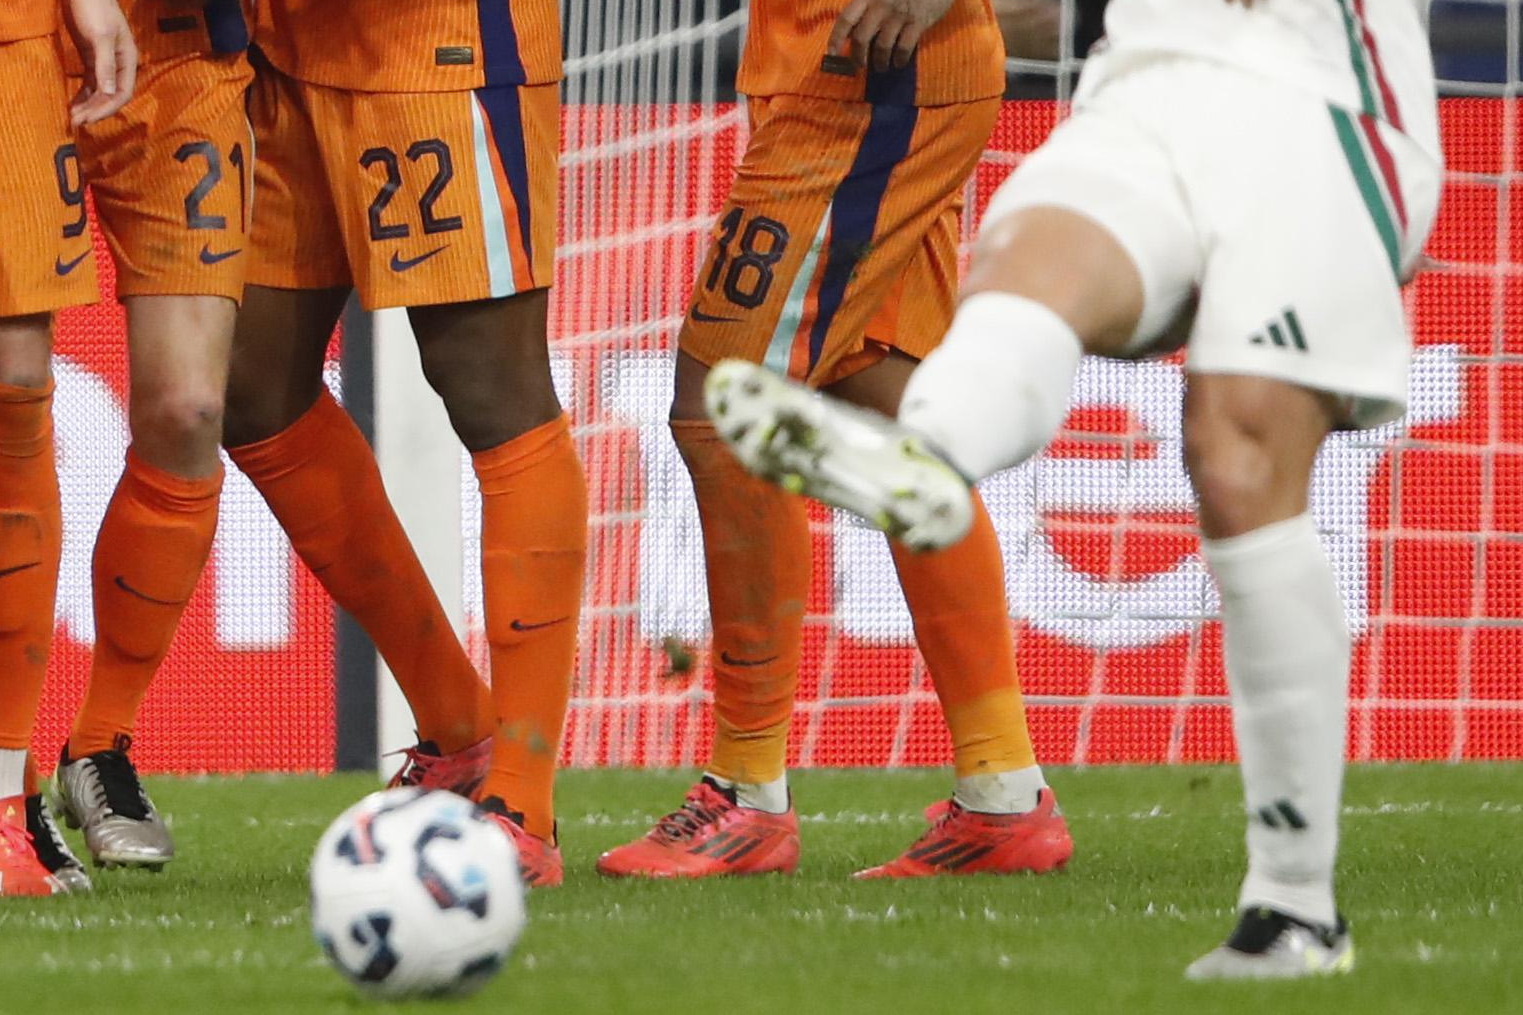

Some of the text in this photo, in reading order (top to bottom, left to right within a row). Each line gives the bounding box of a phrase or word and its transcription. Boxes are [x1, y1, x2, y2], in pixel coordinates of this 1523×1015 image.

[54, 144, 87, 238] 9
[173, 141, 245, 234] 21
[359, 138, 463, 241] 22
[706, 206, 789, 309] 18
